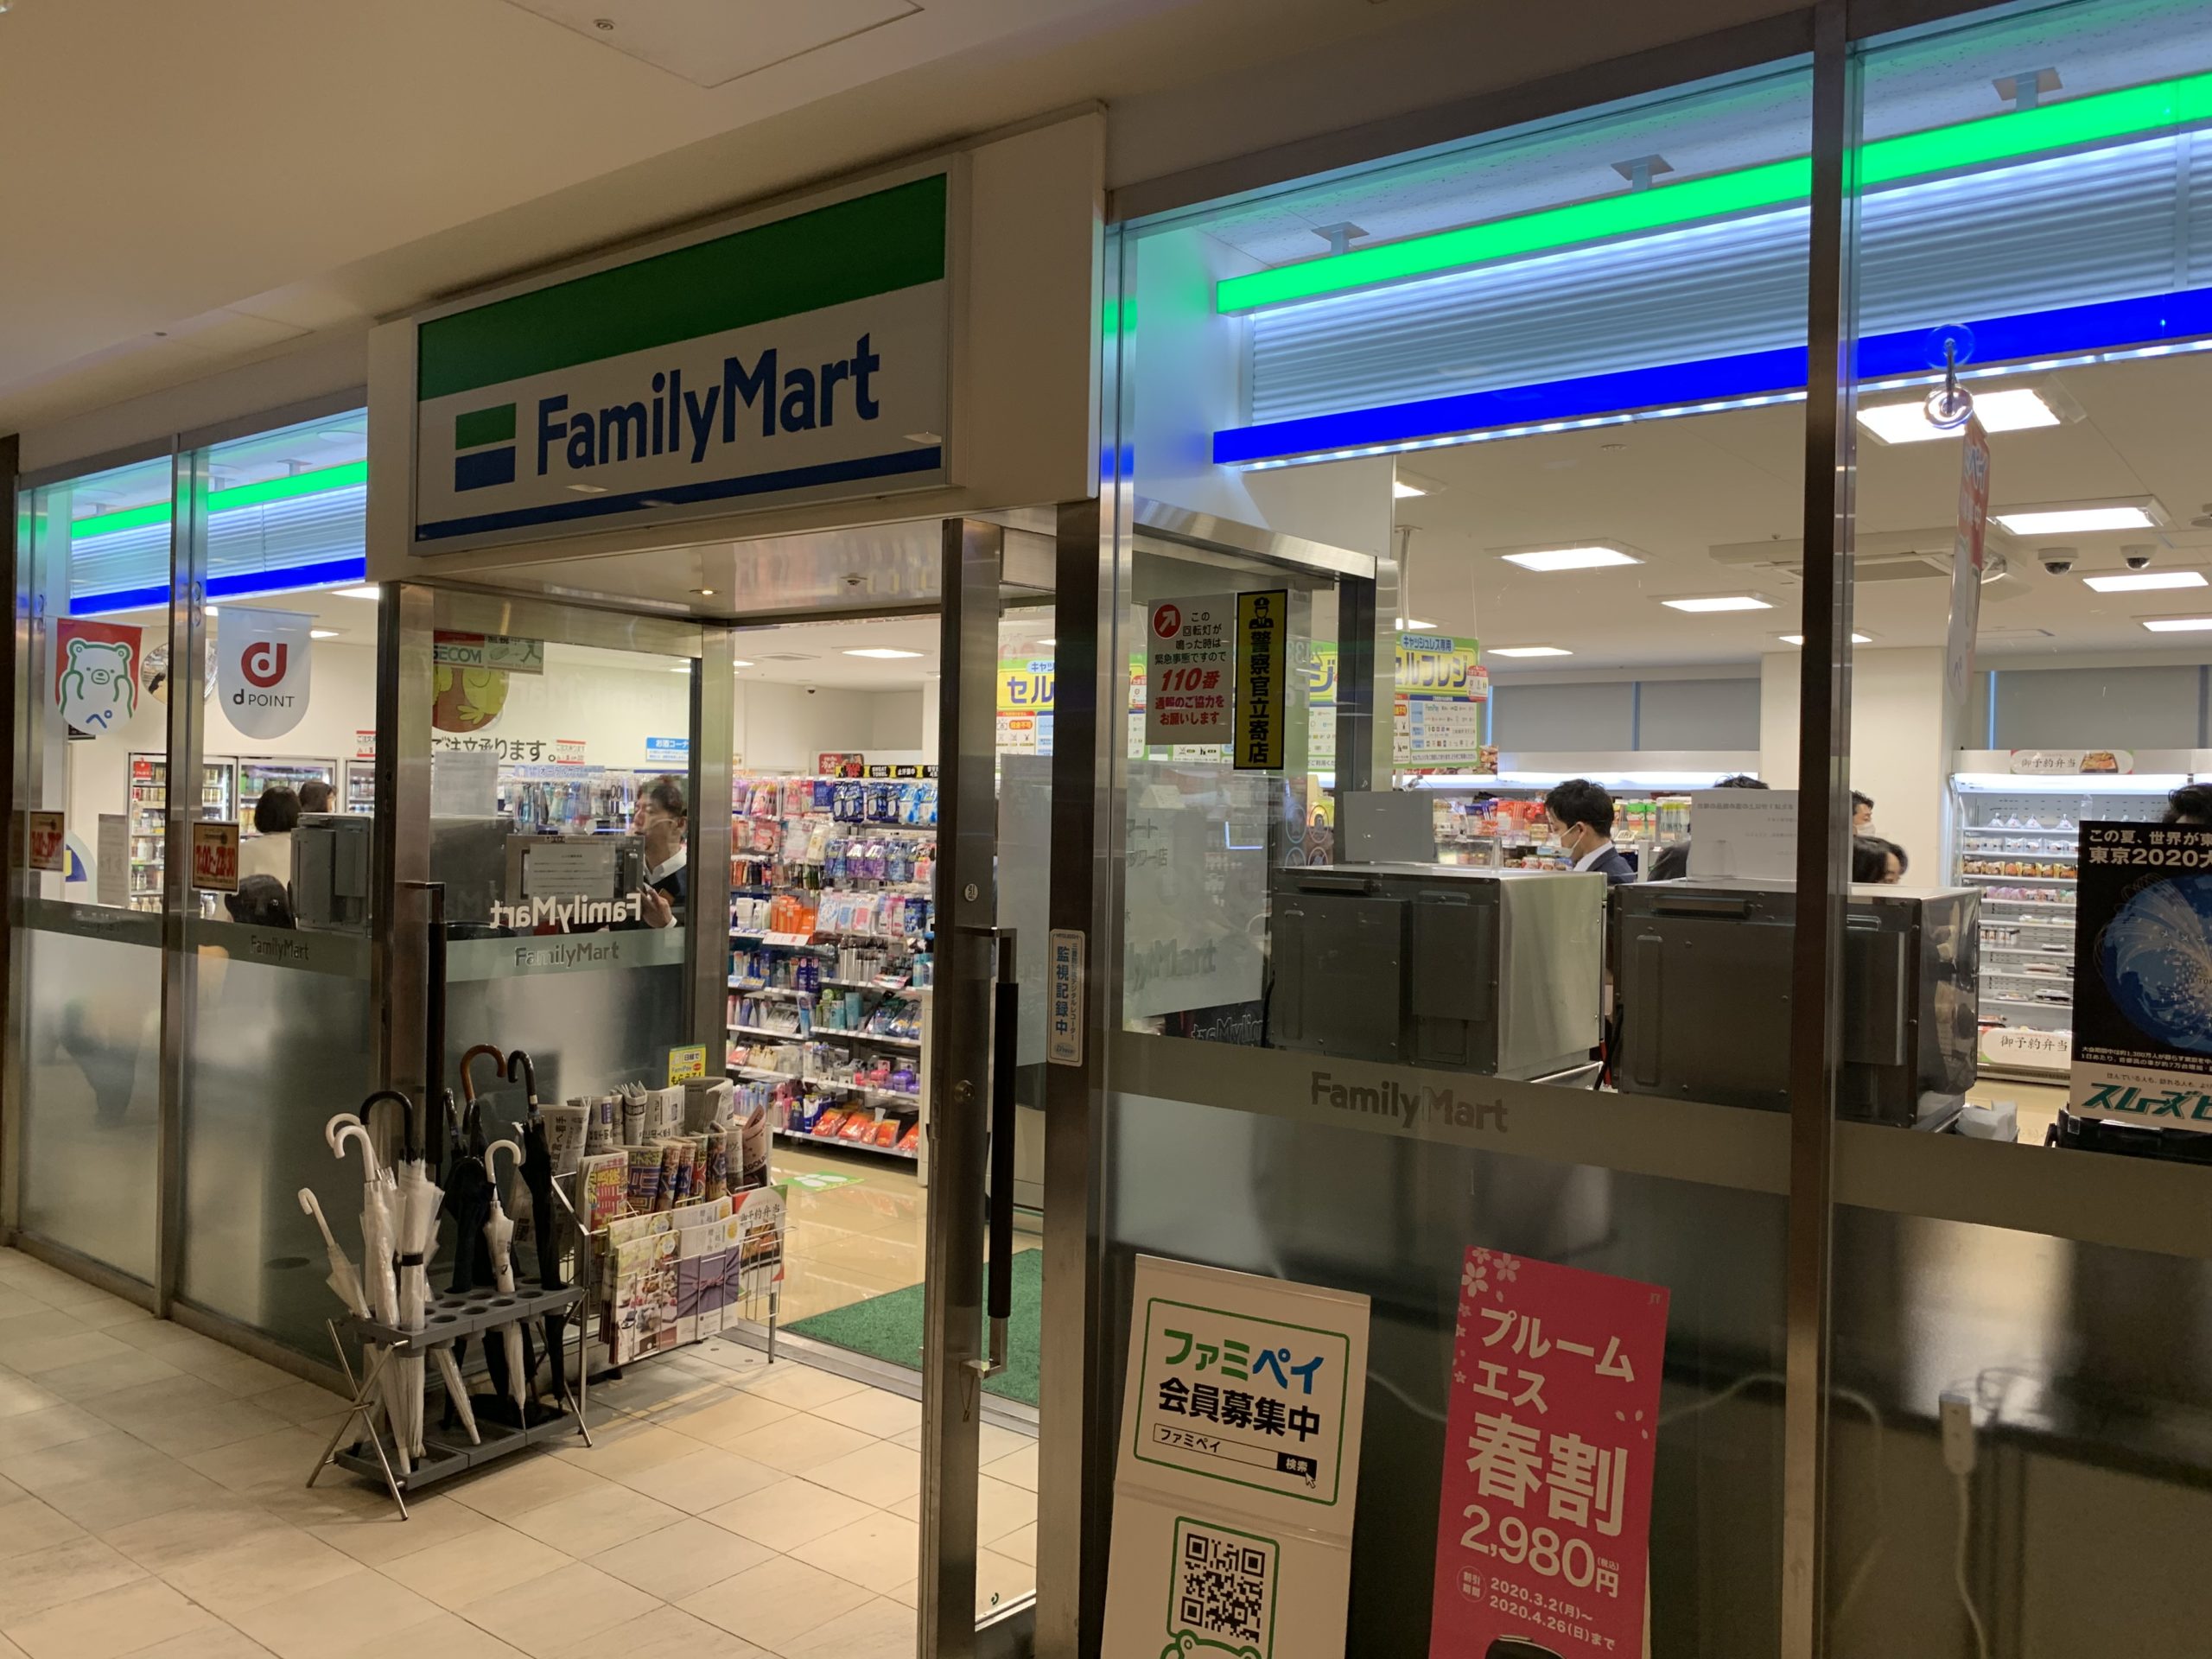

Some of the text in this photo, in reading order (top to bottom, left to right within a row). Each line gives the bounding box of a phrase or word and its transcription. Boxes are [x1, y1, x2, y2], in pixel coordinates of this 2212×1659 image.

[538, 334, 880, 474] FamilyMart
[1183, 623, 1222, 637] 回転灯が
[1192, 612, 1210, 622] この
[1176, 638, 1221, 651] 鳴った時は
[1154, 651, 1226, 665] 緊急事態ですので
[1161, 668, 1221, 692] 110番
[248, 694, 295, 708] POINT
[1155, 696, 1224, 709] 通報のご協力を
[1249, 631, 1272, 764] 警察官立寄店
[1160, 711, 1219, 726] お願いします
[251, 935, 309, 961] FamilyMart
[515, 941, 620, 969] FamilyMart
[1055, 945, 1071, 1036] 監視記録中
[2000, 1035, 2068, 1052] 御予約弁当
[1312, 1071, 1509, 1133] FamilyMart
[1481, 1307, 1635, 1382] プルーム
[1164, 1328, 1324, 1395] ファミペイ
[1472, 1359, 1548, 1414] エス
[1159, 1376, 1320, 1442] 会員募集中
[1160, 1428, 1308, 1473] ファミペイ 検索
[1466, 1411, 1628, 1536] 春割
[1597, 1556, 1620, 1571] (税込)
[1462, 1582, 1481, 1599] 期間
[1463, 1571, 1481, 1586] 割引
[1490, 1595, 1616, 1651] 2020.4.26(日)まで
